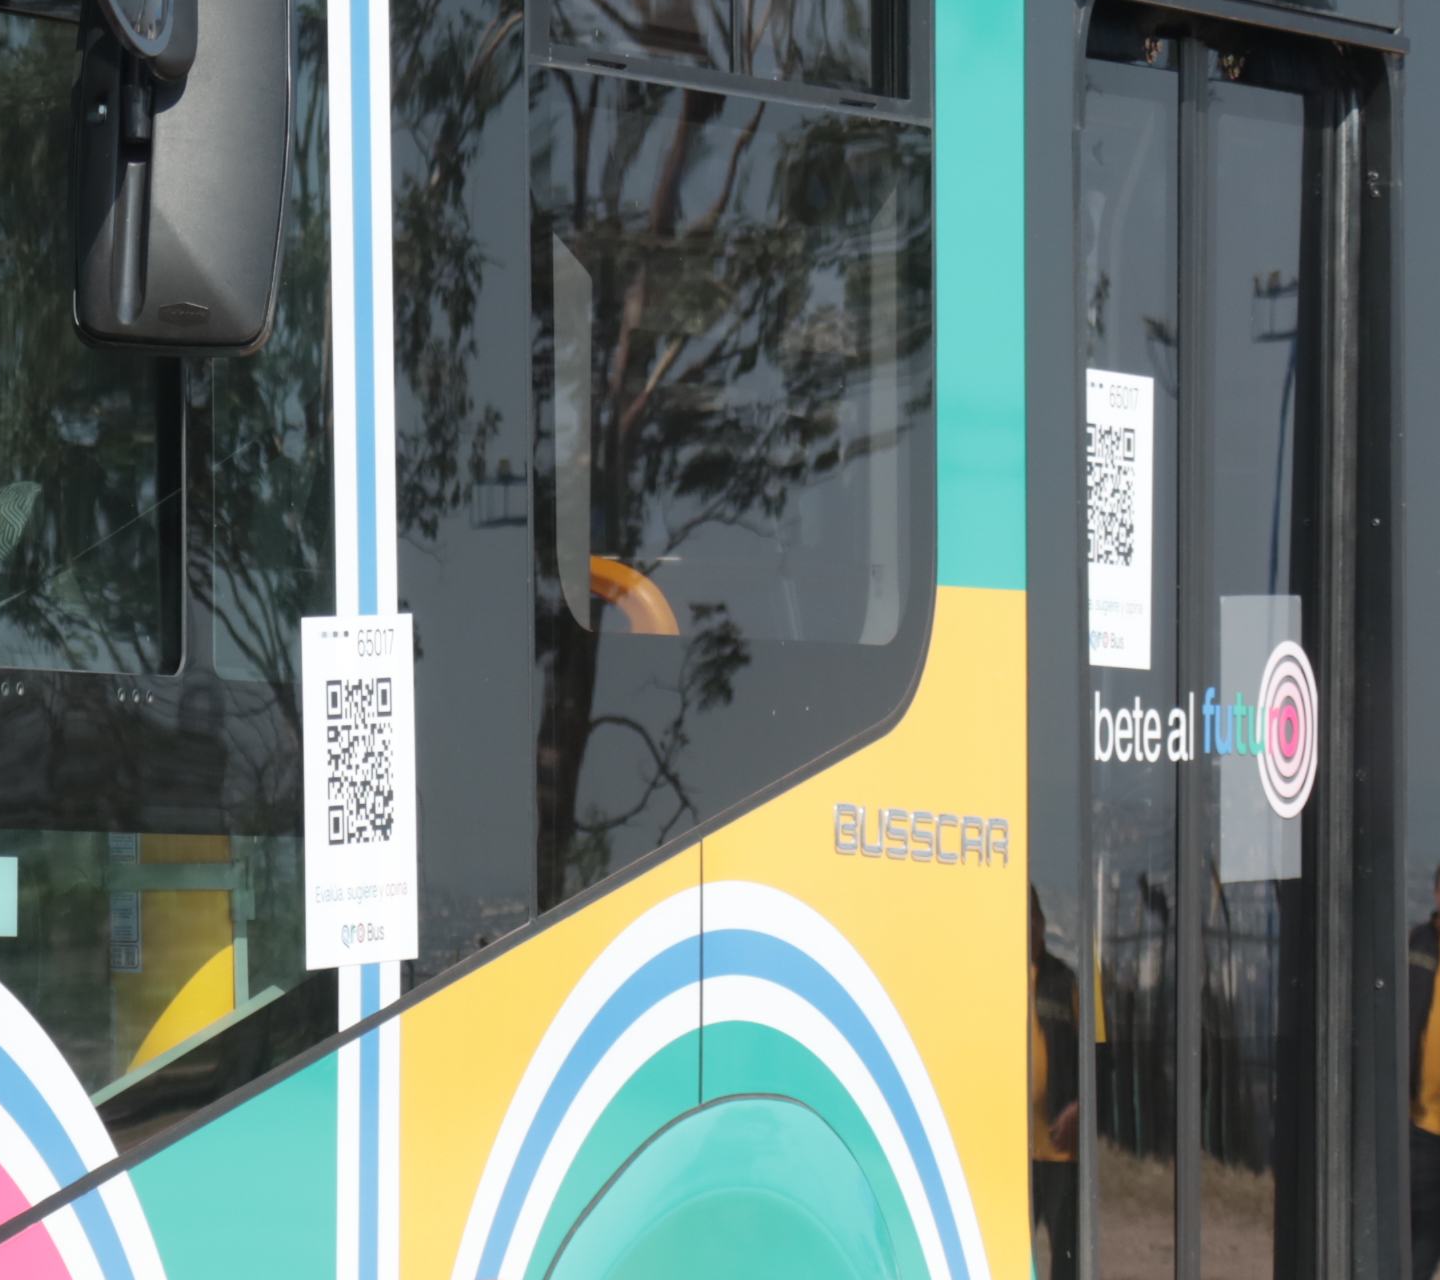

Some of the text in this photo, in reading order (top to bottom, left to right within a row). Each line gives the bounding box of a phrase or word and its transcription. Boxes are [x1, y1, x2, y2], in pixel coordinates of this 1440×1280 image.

[357, 628, 394, 657] 65017
[1167, 691, 1194, 762] al
[1202, 687, 1299, 759] futuro
[834, 803, 1009, 868] BUSSCAR
[367, 922, 385, 941] Bus
